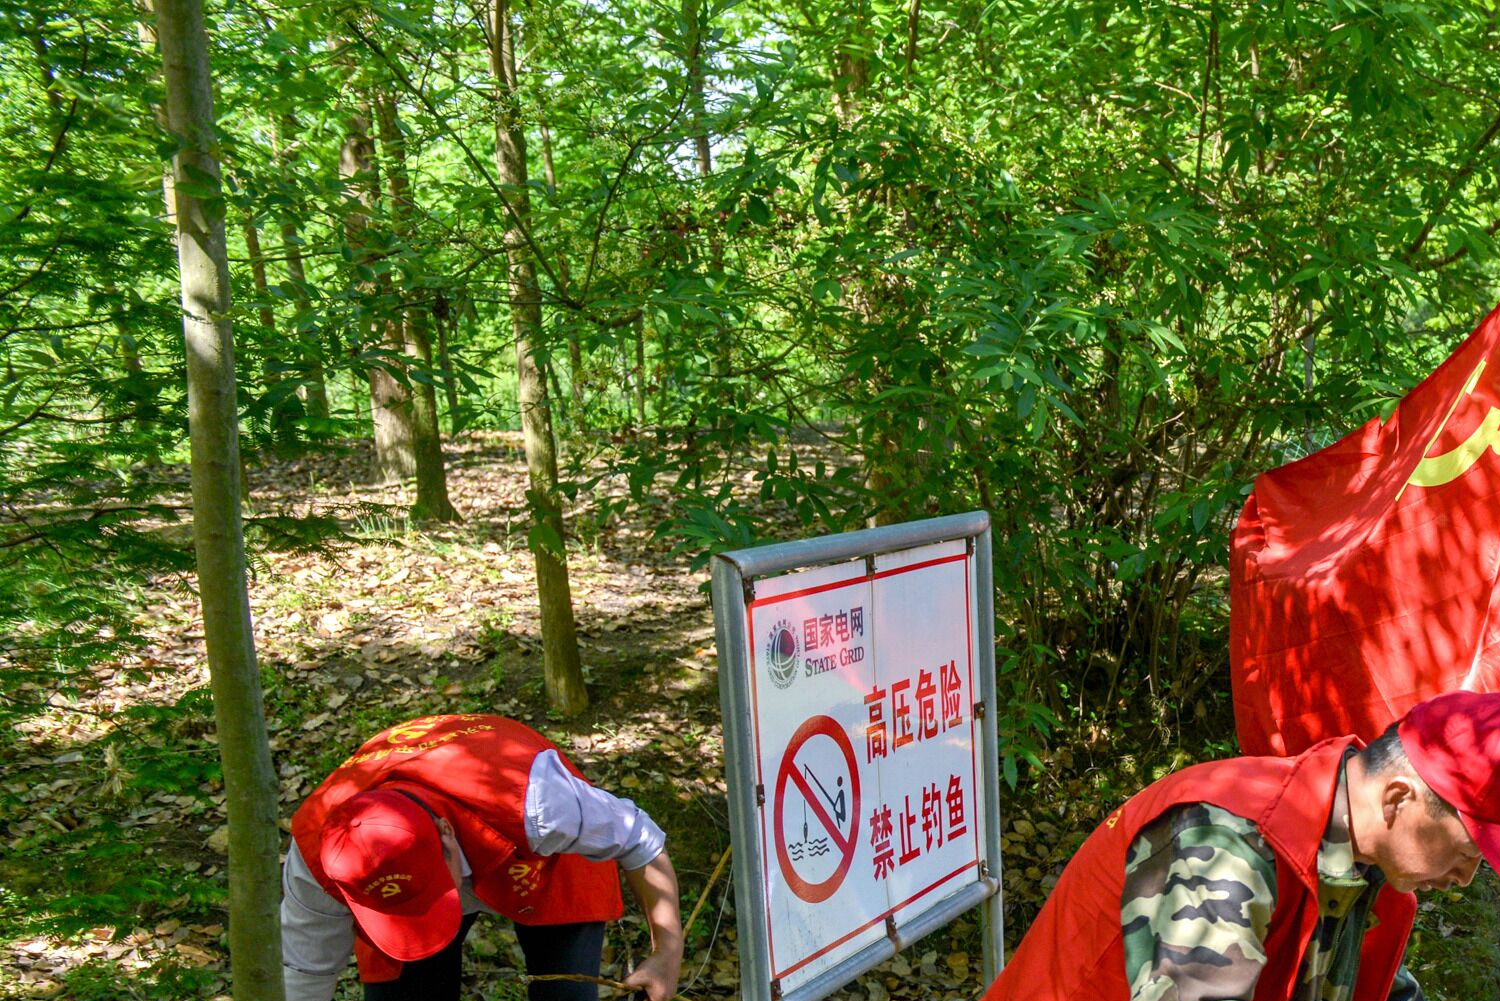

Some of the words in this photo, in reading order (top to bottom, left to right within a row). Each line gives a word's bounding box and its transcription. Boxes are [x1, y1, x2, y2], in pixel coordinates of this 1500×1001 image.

[803, 606, 863, 652] 国家电网
[805, 654, 837, 678] STATE
[839, 646, 865, 667] GRID
[864, 659, 963, 764] 高压危险
[869, 774, 967, 881] 禁止钓鱼
